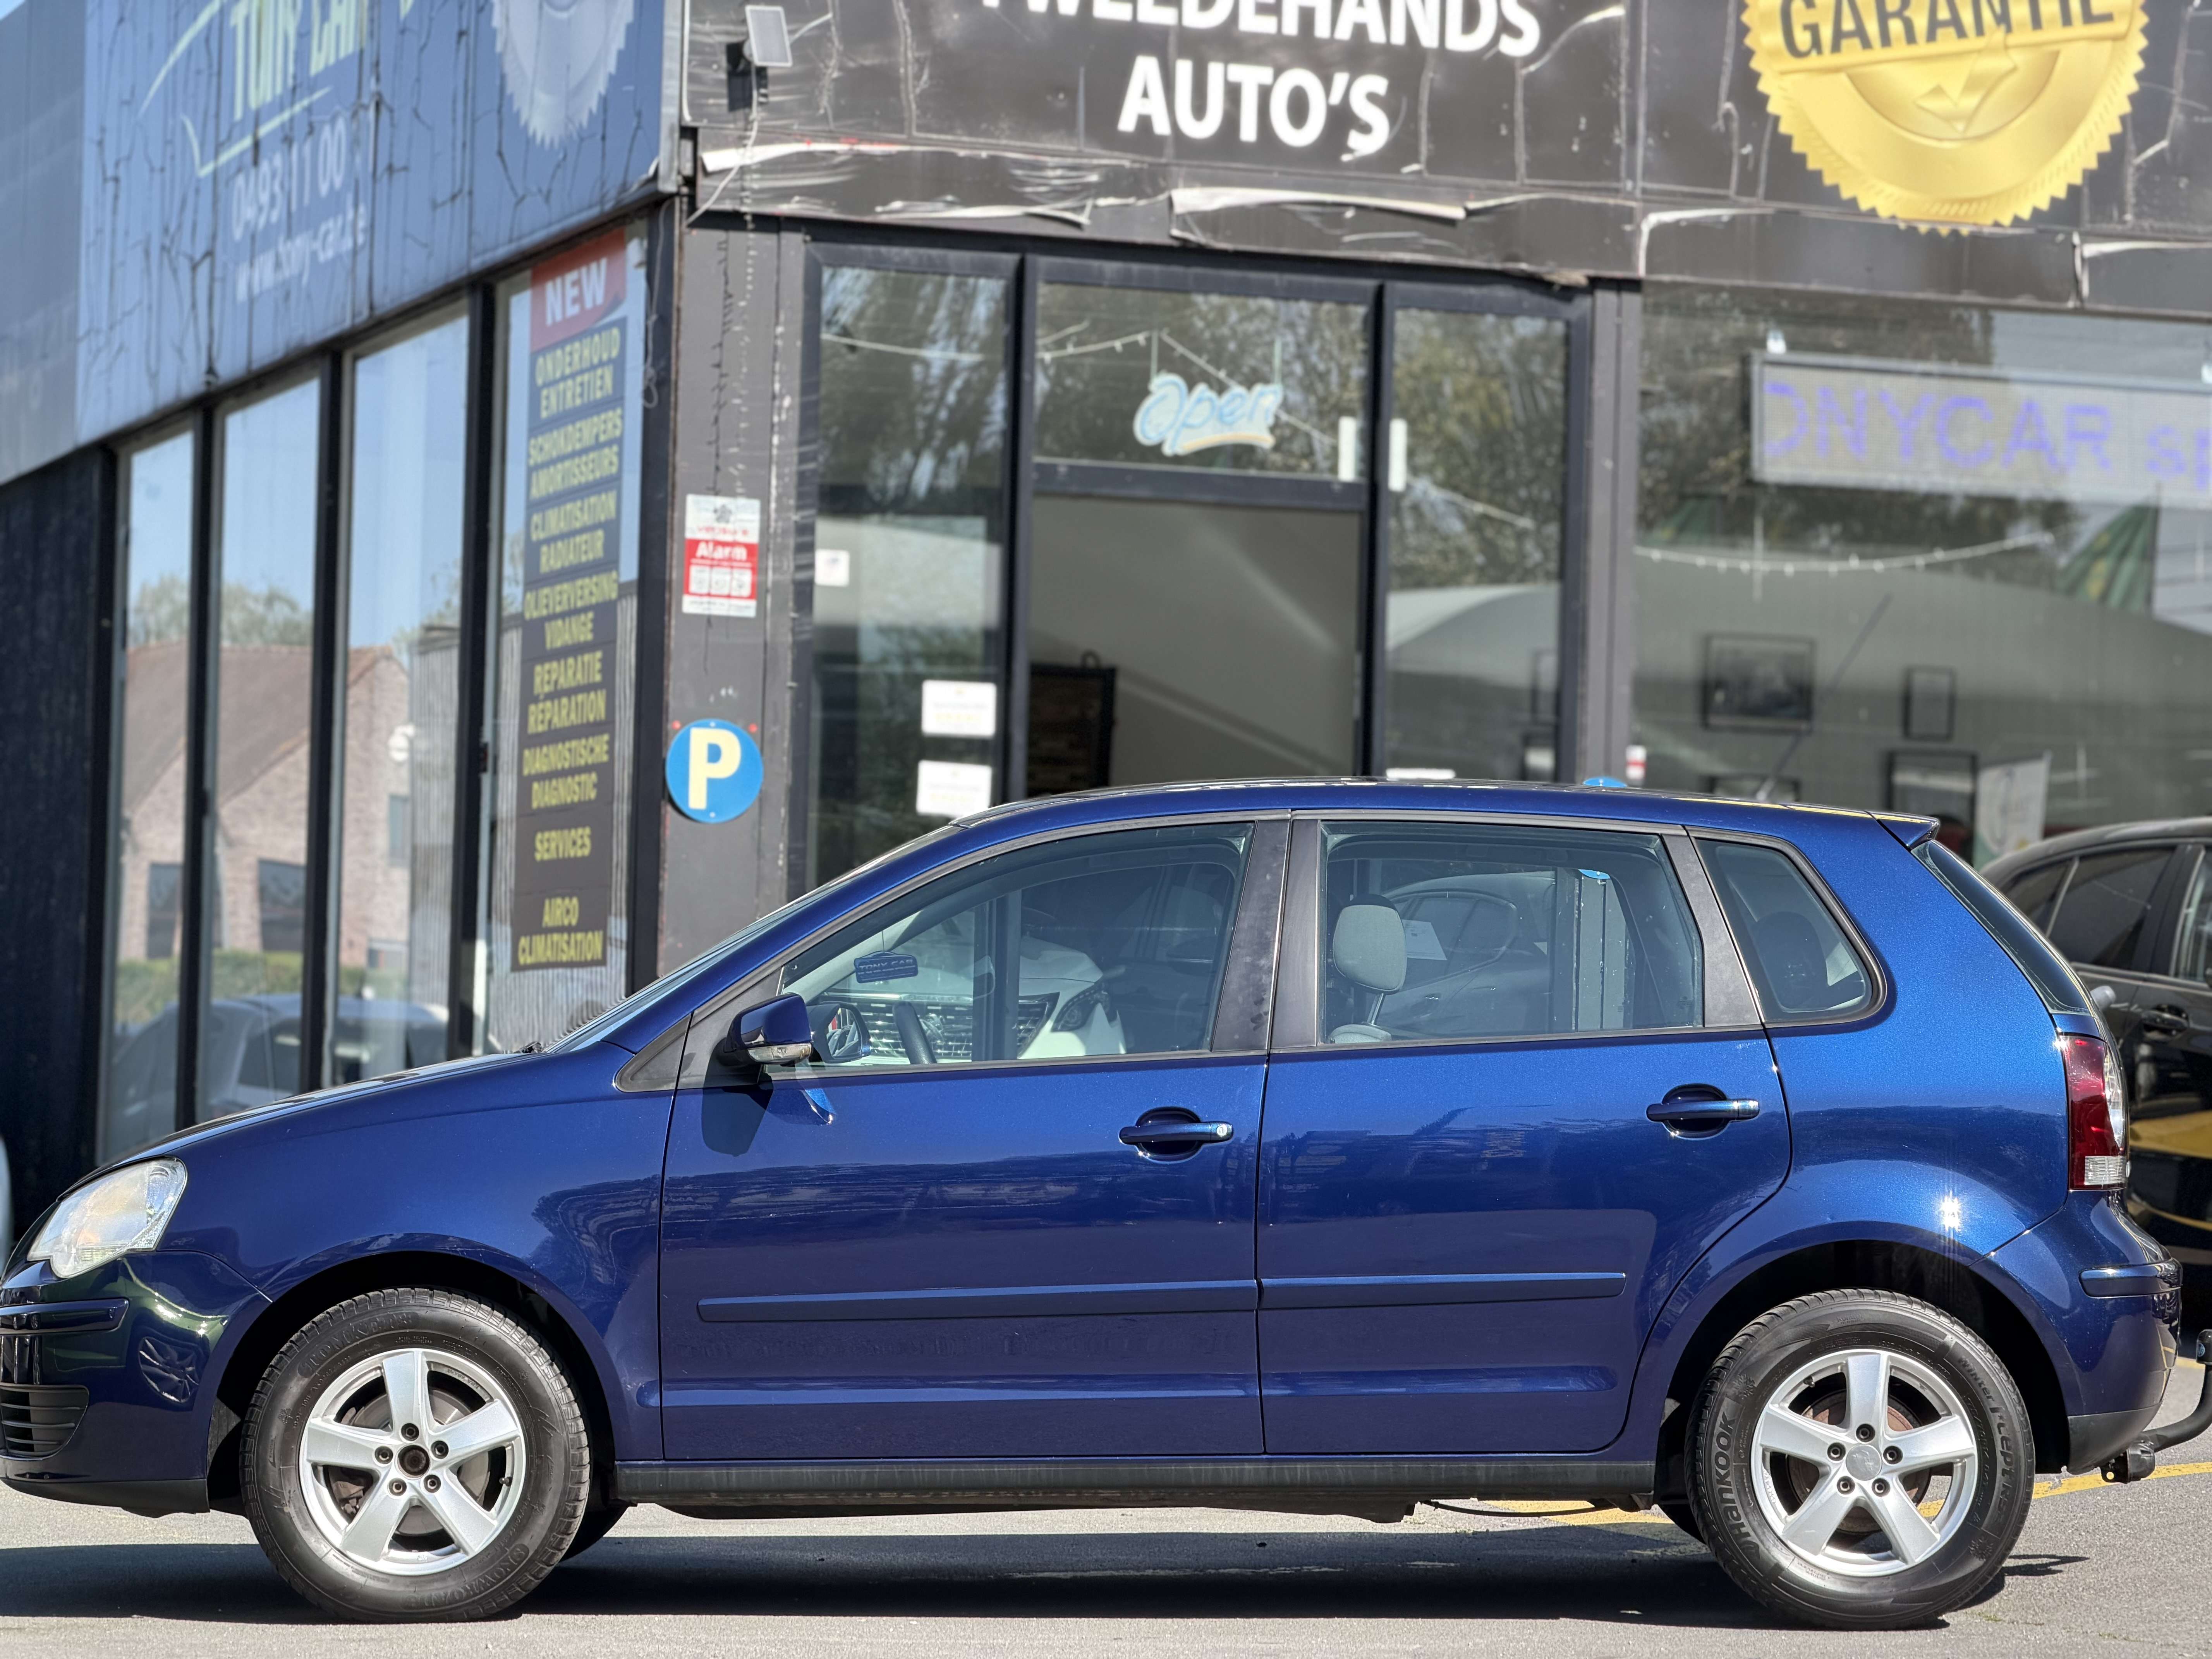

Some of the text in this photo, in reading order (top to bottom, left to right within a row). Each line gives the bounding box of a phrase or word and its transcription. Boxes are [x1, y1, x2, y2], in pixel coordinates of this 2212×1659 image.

[544, 256, 608, 328] NEW
[536, 326, 620, 387] ONDERHOUD
[539, 364, 614, 420] ENTRETIEN
[1134, 373, 1283, 455] Open
[696, 541, 747, 562] Alarm
[533, 650, 603, 696] REPARATIE
[522, 733, 610, 776] DIAGNOSTISCHE
[688, 727, 742, 810] P
[531, 771, 598, 809] DIAGNOSTIC
[534, 826, 592, 862] SERVICES
[542, 896, 579, 928] AIRCO
[517, 930, 604, 966] CLIMATISATION
